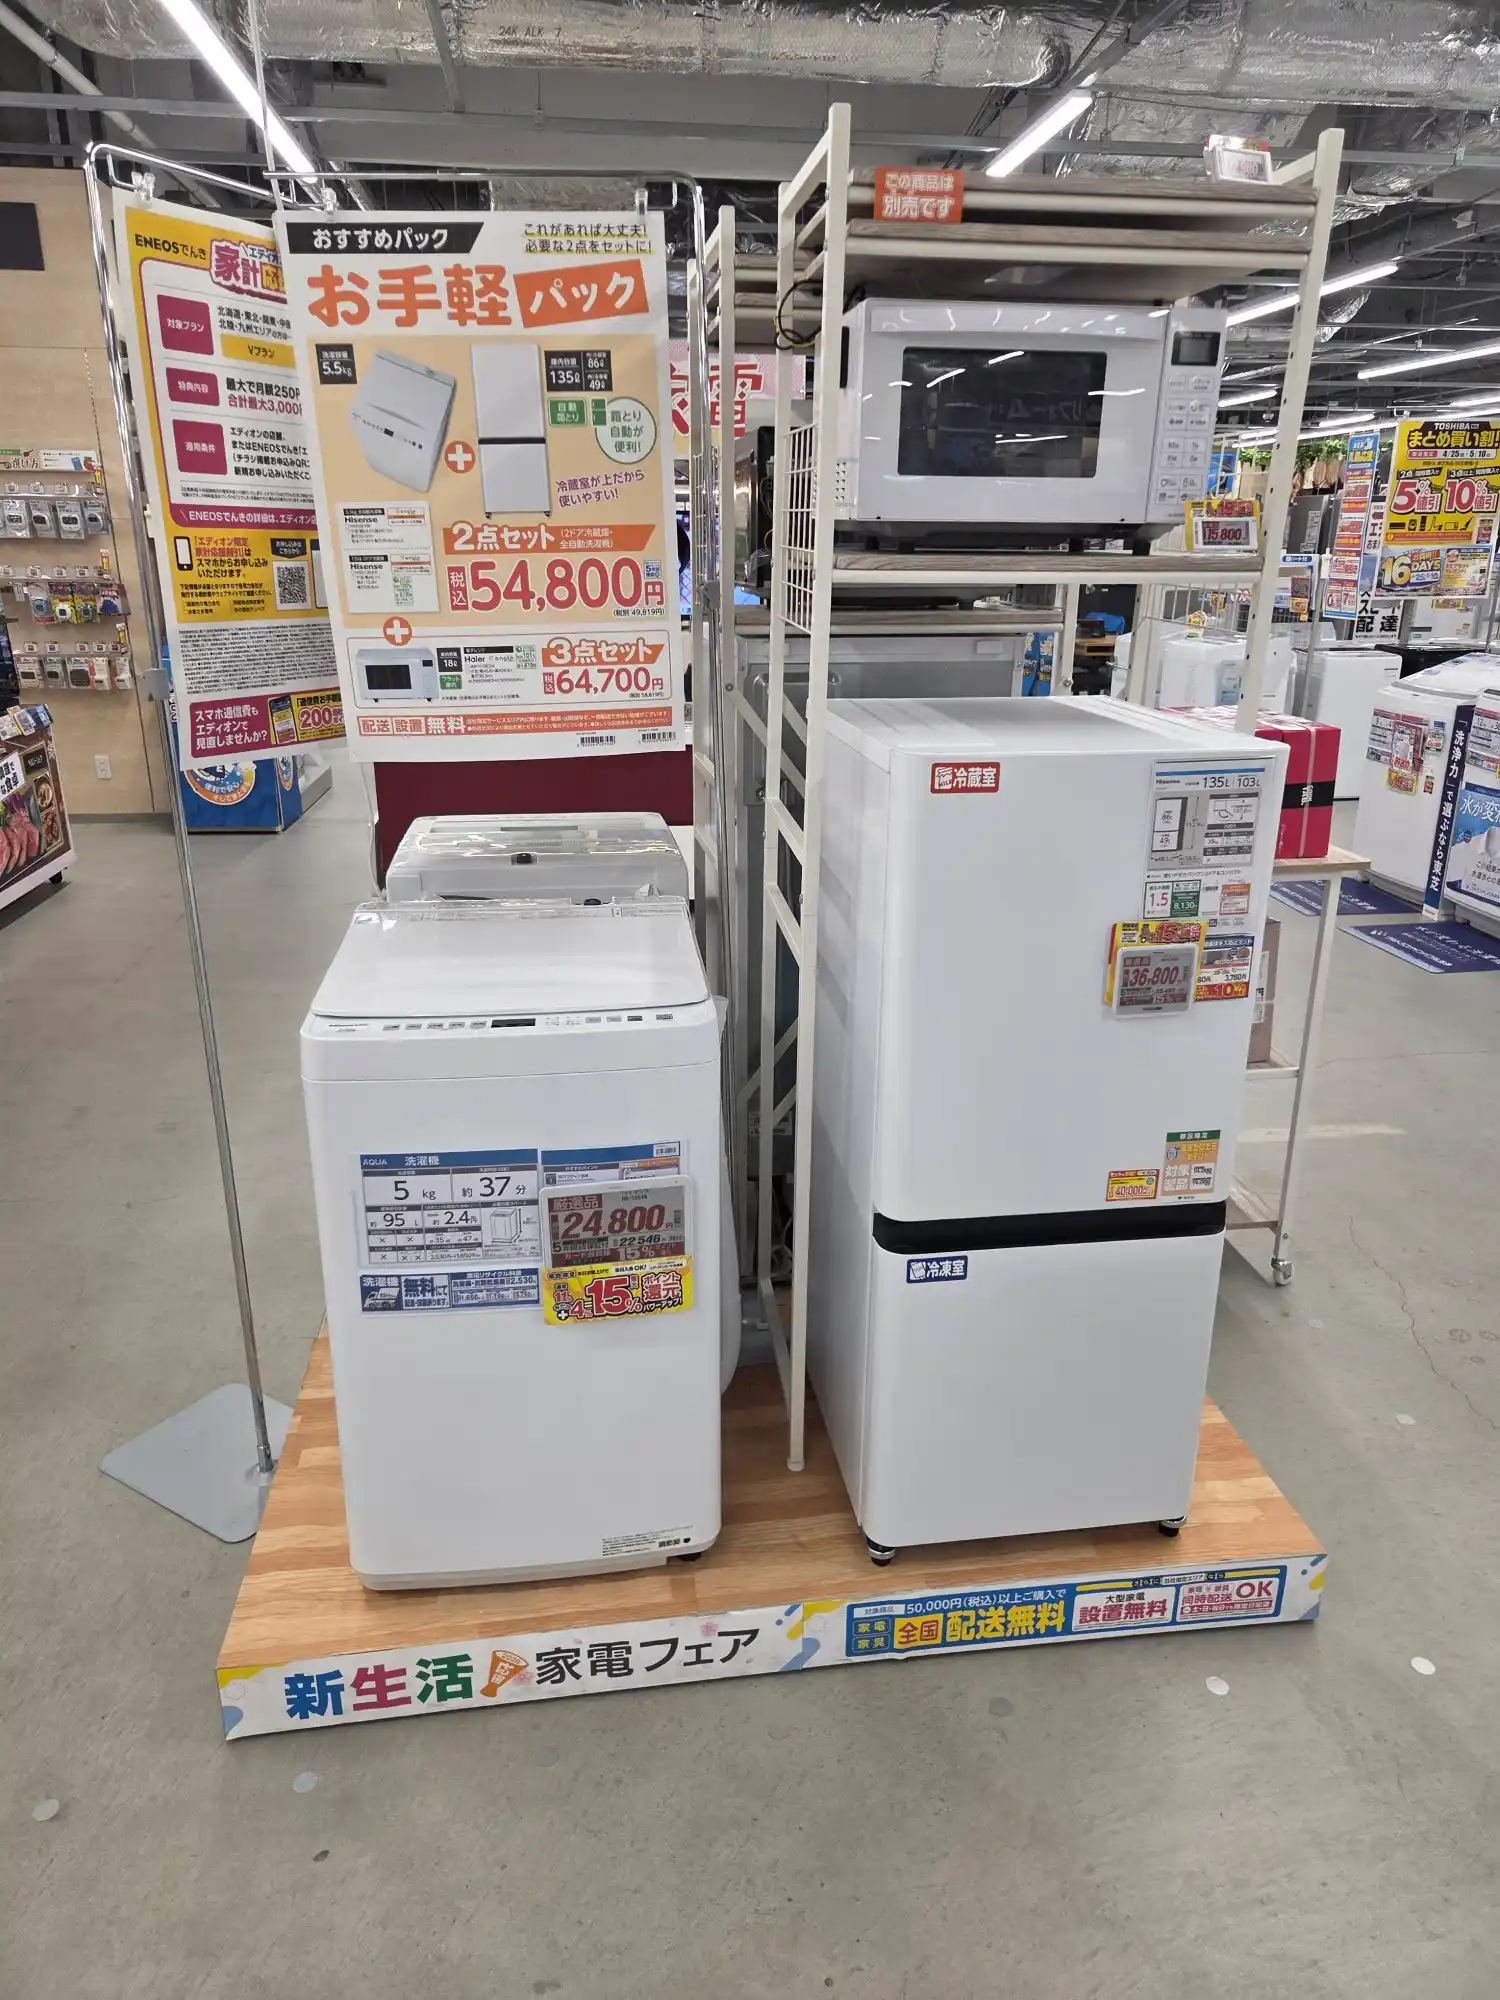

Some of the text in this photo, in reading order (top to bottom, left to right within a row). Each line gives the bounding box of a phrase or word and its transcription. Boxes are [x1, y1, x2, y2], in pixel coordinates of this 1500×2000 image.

[885, 174, 954, 192] この商品は
[883, 195, 955, 218] 別売です
[312, 228, 449, 249] おすすめパック
[524, 223, 647, 237] これがあれば大丈夫!
[134, 233, 207, 260] ENEOSでんき
[525, 239, 652, 254] 必要な2点をセットに!
[249, 247, 283, 267] エディオ
[307, 263, 512, 328] お手軽
[530, 271, 636, 315] パック
[322, 361, 352, 377] 5.5kg
[228, 394, 302, 416] 合計最大3,000
[1409, 430, 1500, 448] まとめ買い割!
[556, 469, 645, 493] 冷蔵室が上だから
[559, 489, 619, 508] 使いやすい!
[1416, 494, 1440, 511] 値引
[1475, 494, 1497, 510] 値引
[452, 523, 555, 552] 2点セット
[197, 558, 269, 568] スマホからお申し込み
[1382, 555, 1412, 585] 16
[1411, 561, 1440, 571] DAYS
[449, 571, 467, 608] 税込
[470, 556, 664, 612] 54,800円
[1356, 615, 1400, 633] 配達
[550, 637, 654, 665] 3点セット
[556, 666, 664, 695] 64,700円
[195, 704, 259, 721] スマホ通信費も
[299, 706, 333, 730] 200
[196, 721, 249, 736] エディオンで
[361, 716, 466, 734] 配送 設置 無料
[196, 730, 268, 750] 見直しませんか?
[953, 767, 997, 788] 冷蔵室
[1149, 892, 1169, 907] 1.5
[405, 1156, 440, 1166] 洗濯機
[394, 1176, 527, 1200] 5 kg 約 37 分
[383, 1213, 405, 1227] 95
[644, 1272, 680, 1284] ポイント
[927, 1259, 965, 1278] 冷凍室
[362, 1276, 400, 1287] 洗濯機
[404, 1276, 448, 1298] 無料にて
[643, 1283, 681, 1301] 還元
[643, 1297, 683, 1312] パワーアップ!
[1105, 1591, 1146, 1604] 大型家電
[1181, 1592, 1233, 1606] 同時配送
[1235, 1580, 1273, 1599] OK
[946, 1599, 1066, 1643] 配送無料
[1079, 1598, 1168, 1625] 設置無料
[857, 1621, 889, 1634] 家電
[897, 1618, 940, 1645] 全国
[857, 1636, 886, 1649] 家具
[535, 1627, 761, 1686] 家電フェア
[284, 1653, 475, 1721] 新生活
